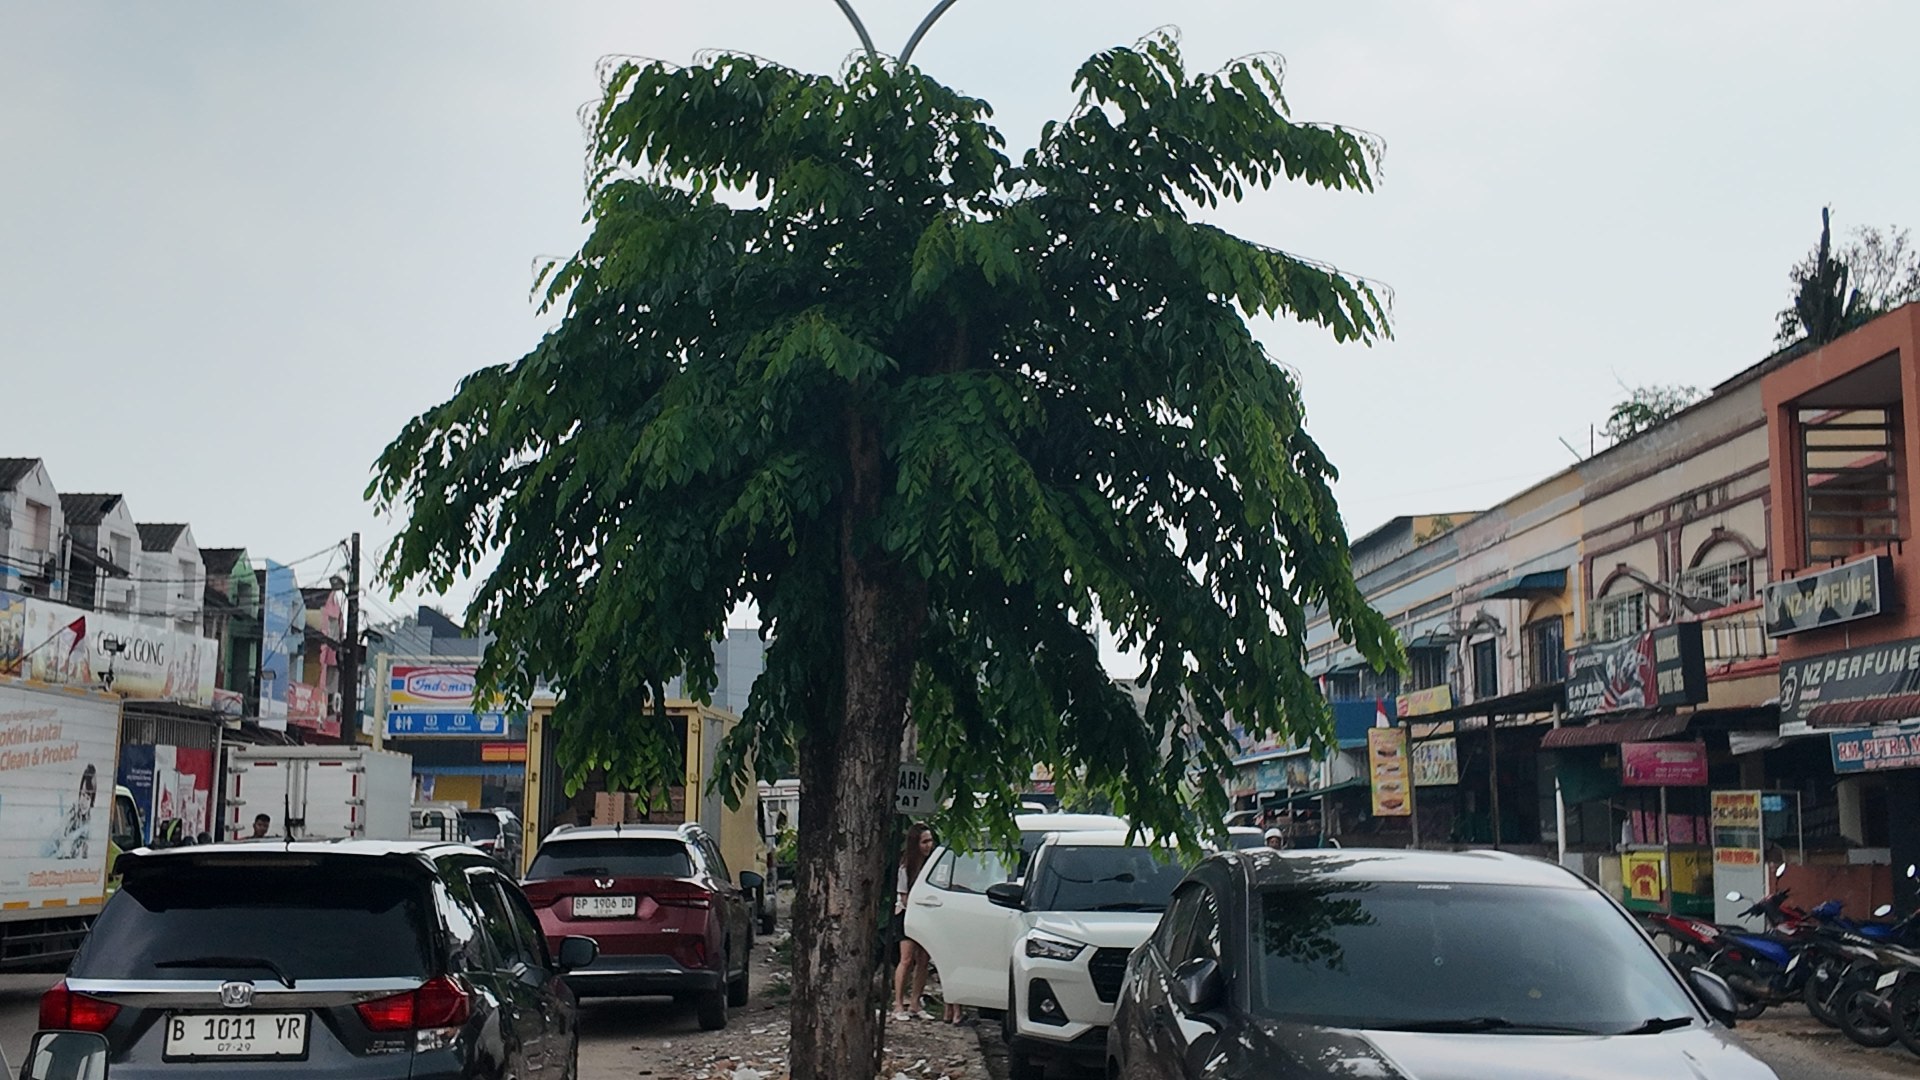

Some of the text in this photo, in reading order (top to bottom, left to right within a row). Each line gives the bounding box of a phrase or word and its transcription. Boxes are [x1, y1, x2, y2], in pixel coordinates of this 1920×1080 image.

[1785, 574, 1872, 618] NZ PERFUME
[134, 637, 165, 666] GONG
[1801, 644, 1920, 688] NZ PERFUME
[412, 678, 474, 692] Indomar
[29, 720, 63, 744] Lantai
[0, 740, 79, 771] Clean & Protect
[1862, 735, 1910, 759] PUTRA
[898, 770, 931, 791] ARIS
[593, 898, 617, 909] 1906
[621, 897, 633, 909] DD
[172, 1018, 301, 1041] B 1011 YR
